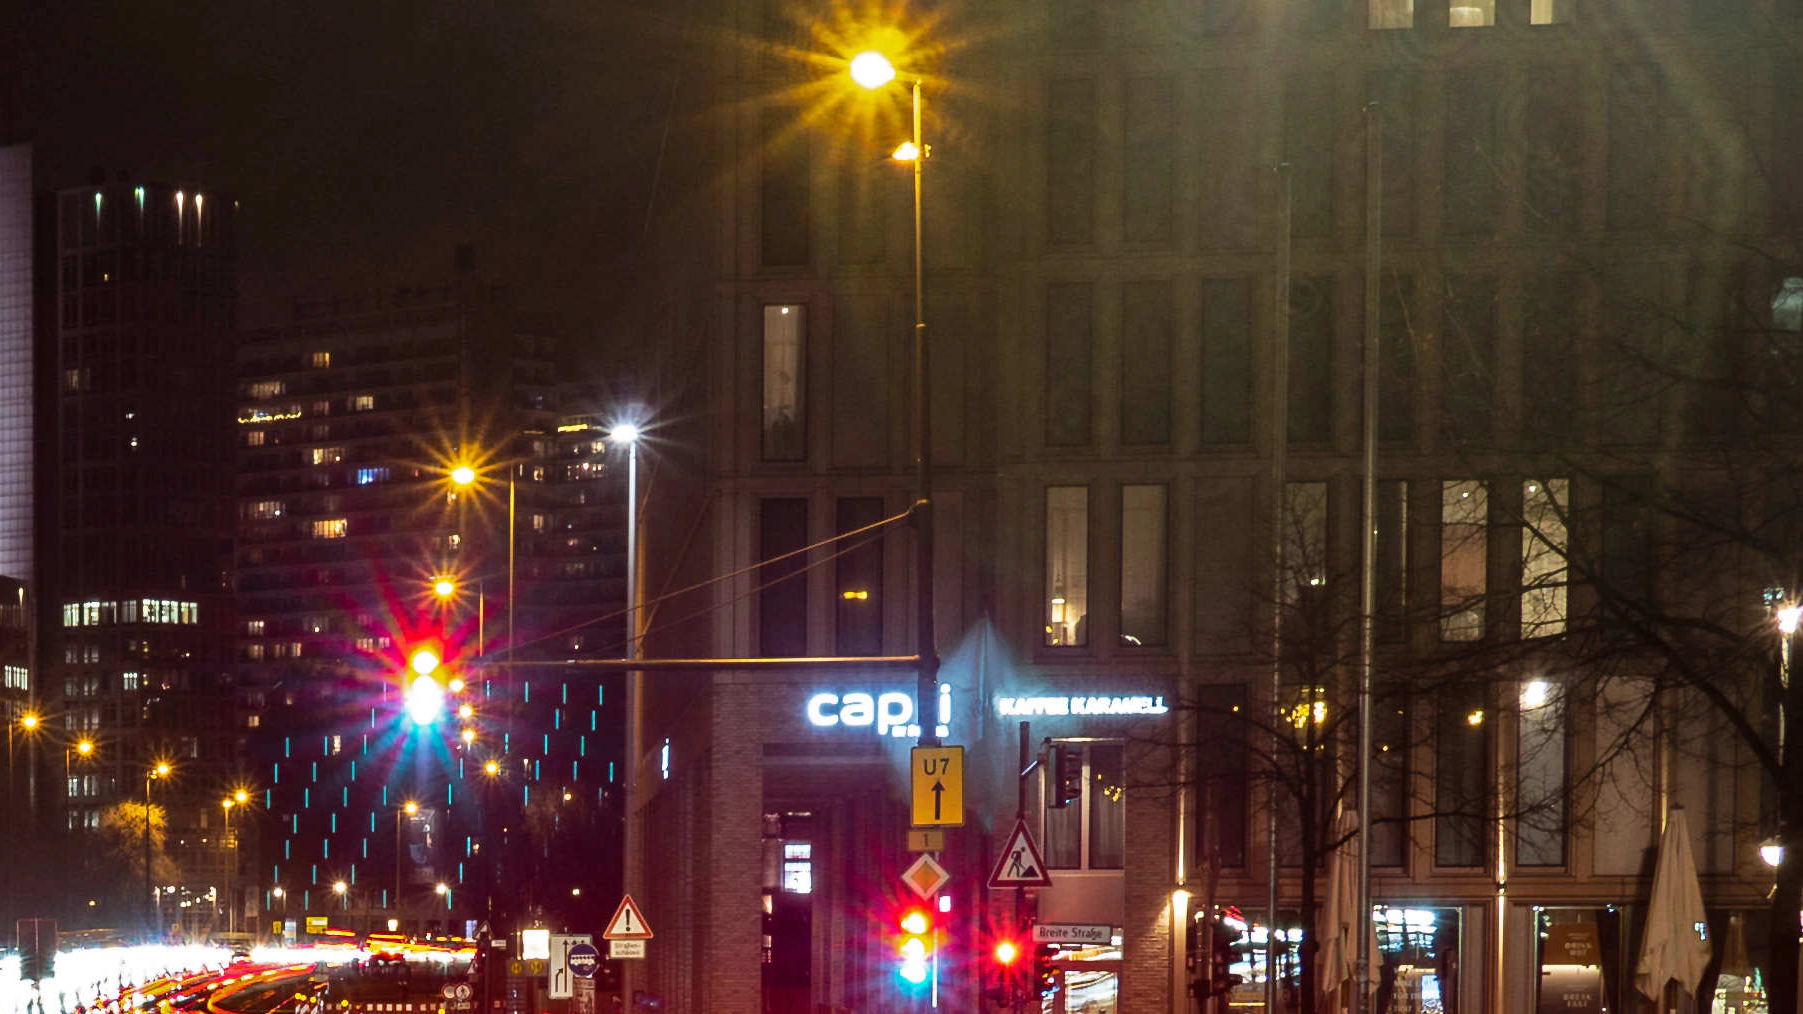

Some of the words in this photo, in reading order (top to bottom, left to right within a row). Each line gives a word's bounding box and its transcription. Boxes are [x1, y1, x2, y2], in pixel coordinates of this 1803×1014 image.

[807, 683, 952, 736] capi
[1070, 697, 1168, 715] KARAMELL
[924, 757, 950, 776] U7
[1039, 927, 1068, 938] Breite
[1071, 927, 1103, 941] Straße
